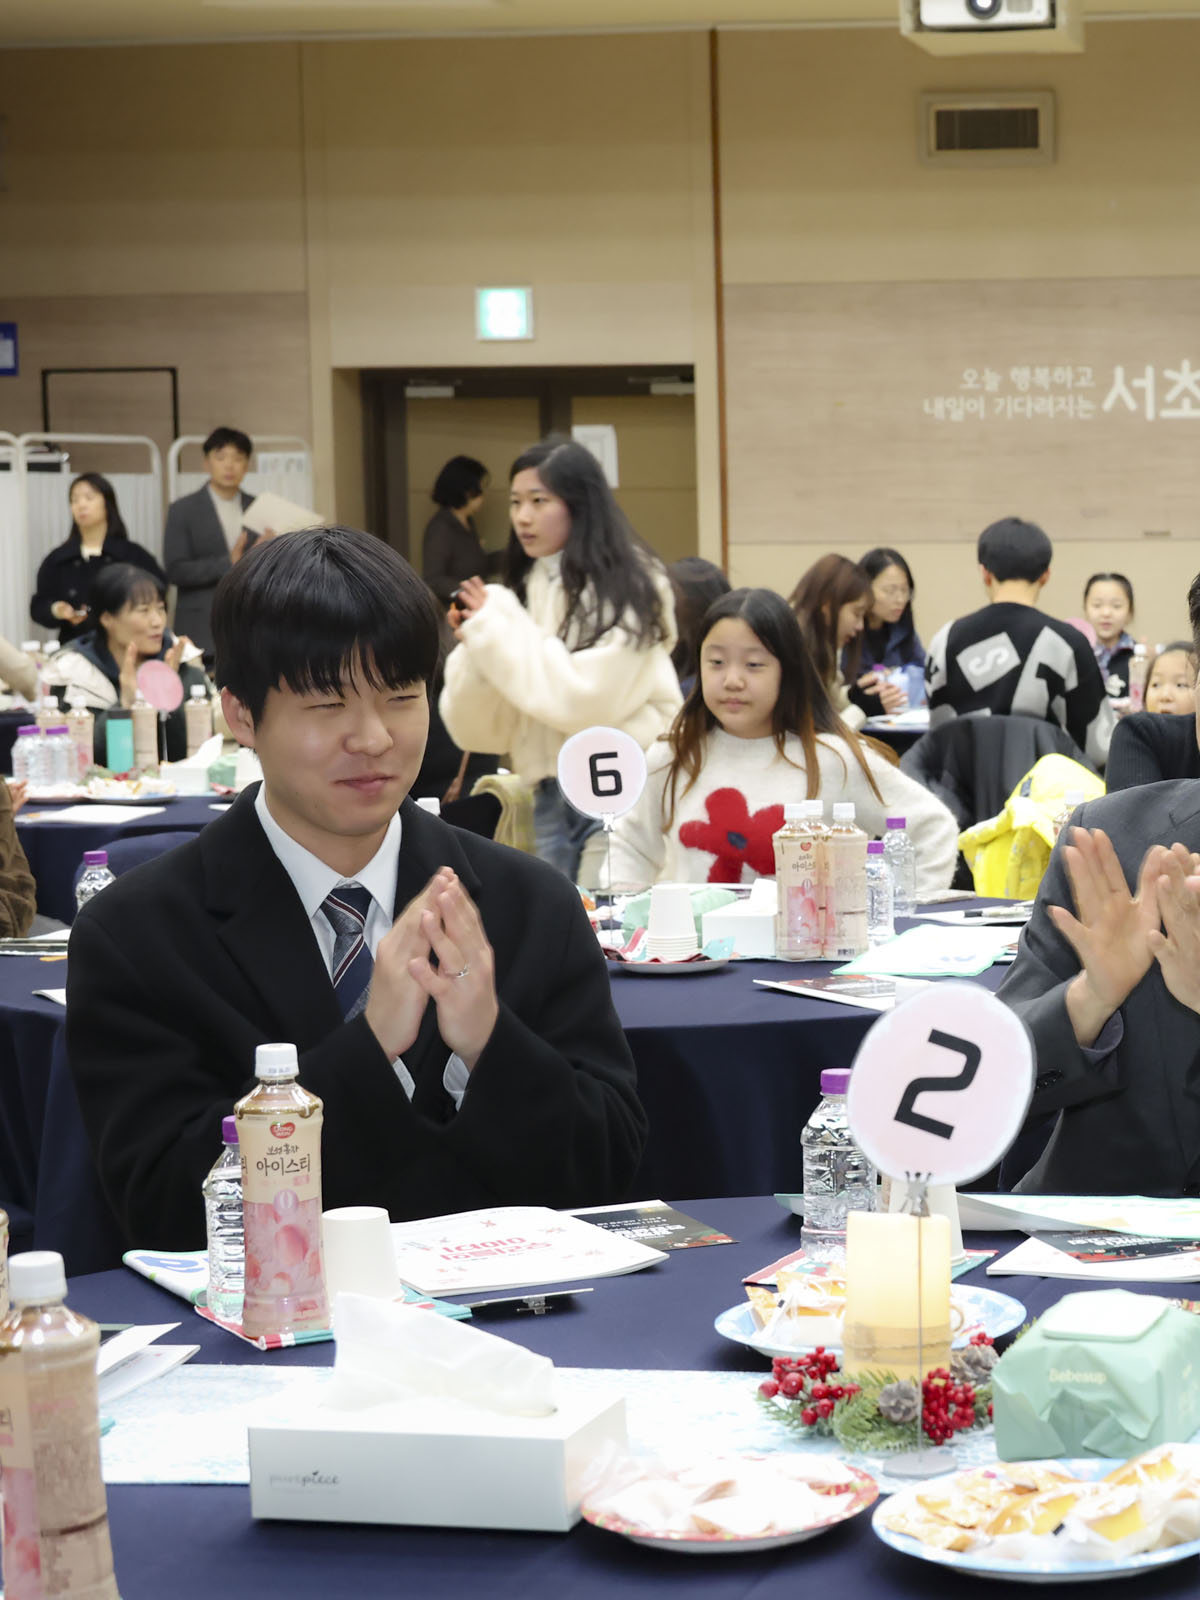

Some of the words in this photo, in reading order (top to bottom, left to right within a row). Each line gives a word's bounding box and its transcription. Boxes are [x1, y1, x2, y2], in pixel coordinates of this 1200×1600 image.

[959, 366, 1002, 392] 오늘
[1010, 366, 1096, 390] 행복하고
[924, 395, 985, 421] 내일이
[589, 751, 623, 797] 6
[893, 1028, 982, 1140] 2
[256, 1153, 311, 1177] 아이스티
